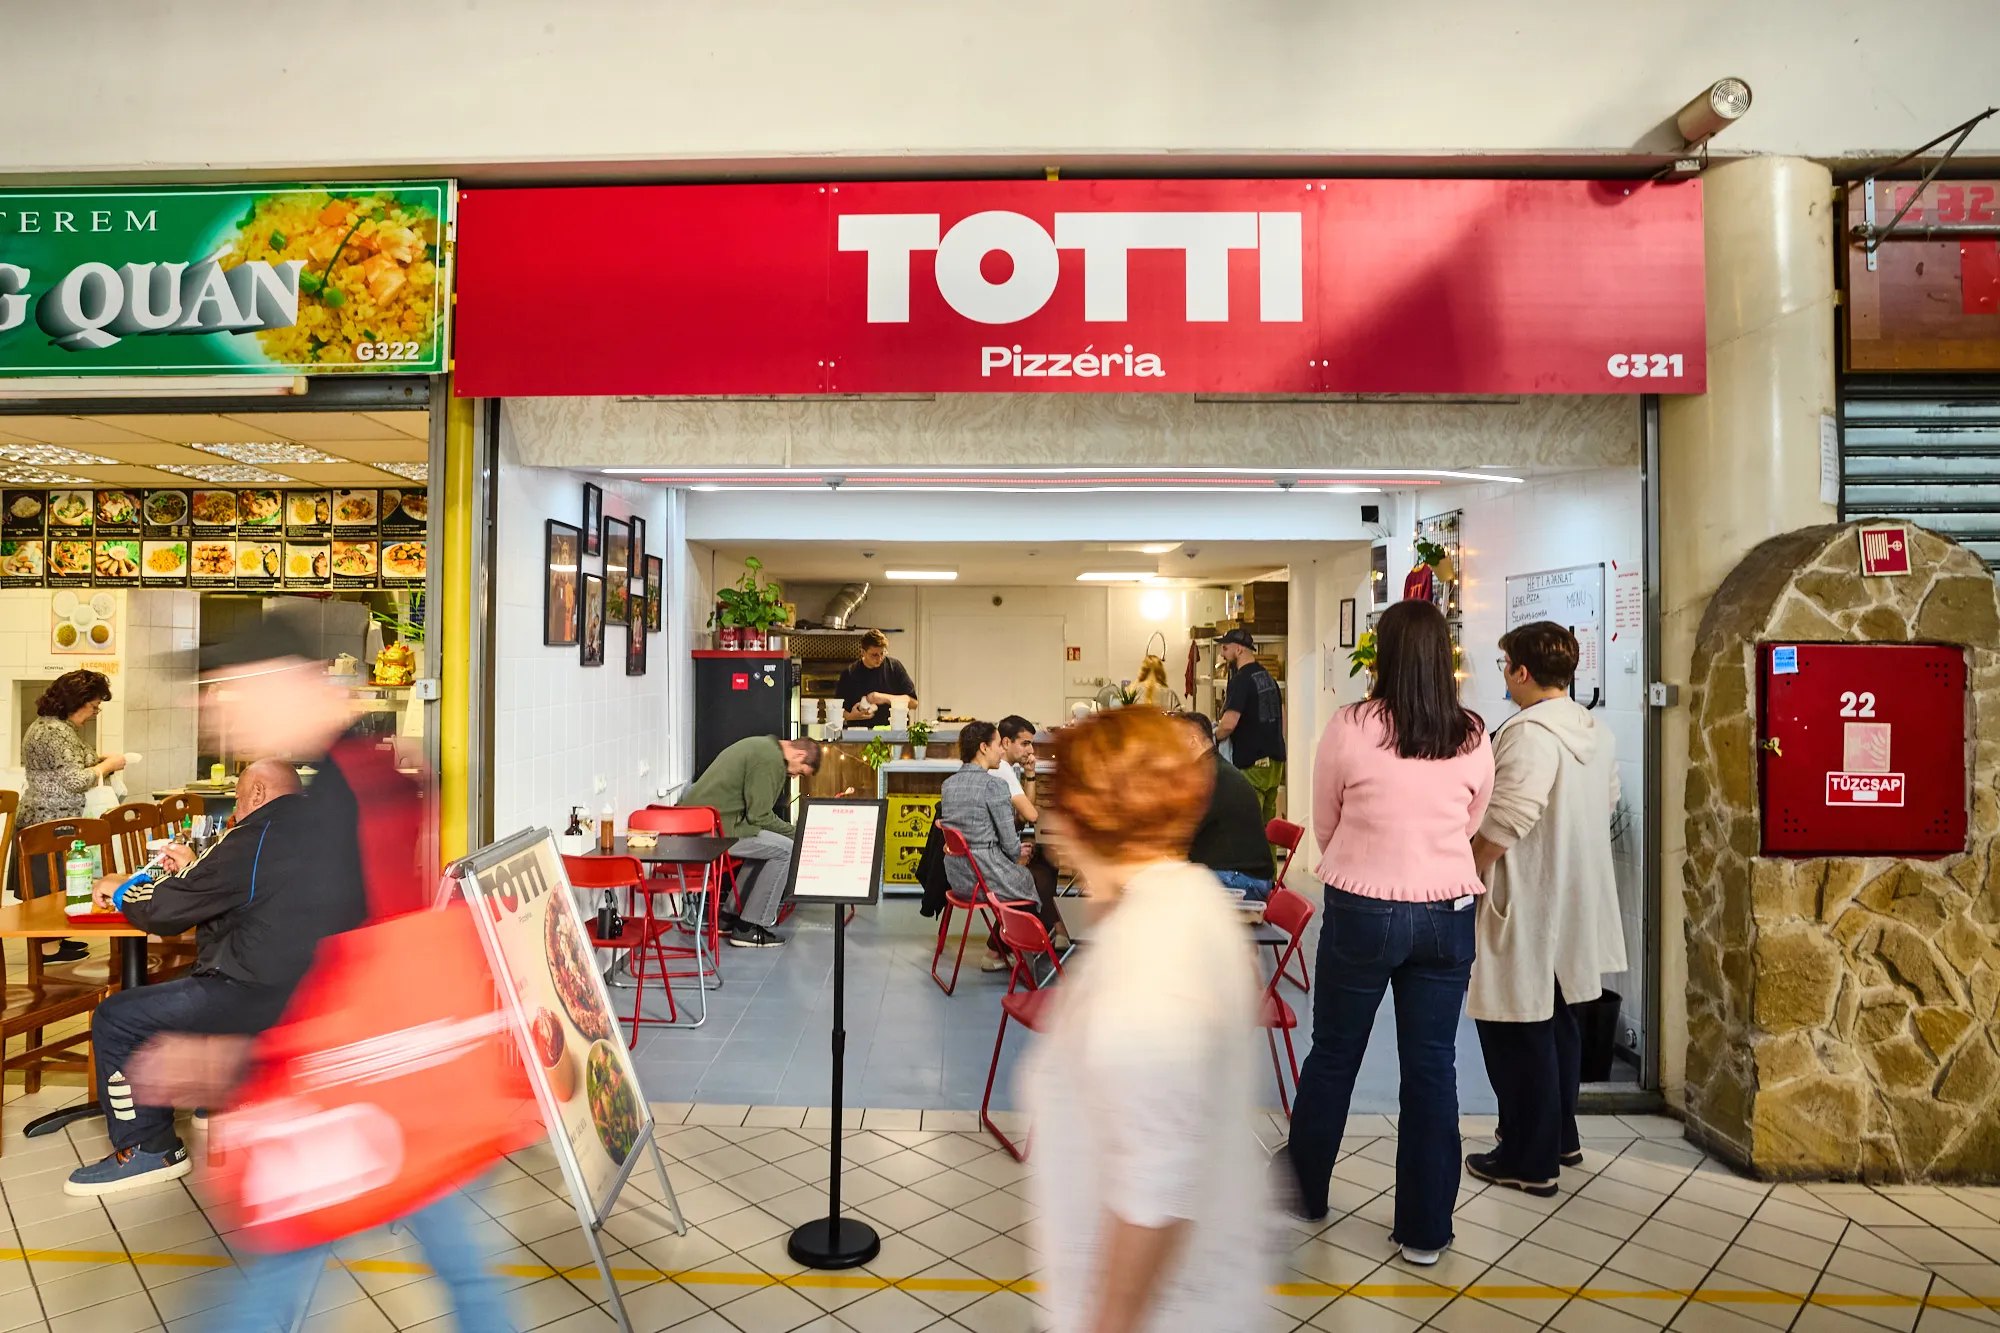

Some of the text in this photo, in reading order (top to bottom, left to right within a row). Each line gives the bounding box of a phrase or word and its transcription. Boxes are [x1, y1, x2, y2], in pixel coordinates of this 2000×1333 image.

[0, 211, 158, 233] EREM
[838, 210, 1303, 325] TOTTI
[60, 243, 308, 350] QUÁN
[356, 342, 420, 362] G322
[981, 344, 1166, 378] Pizzéria
[1606, 353, 1684, 378] G321
[1839, 691, 1876, 718] 22
[1830, 776, 1901, 792] TŰZCSAP
[479, 850, 548, 923] TOTTI
